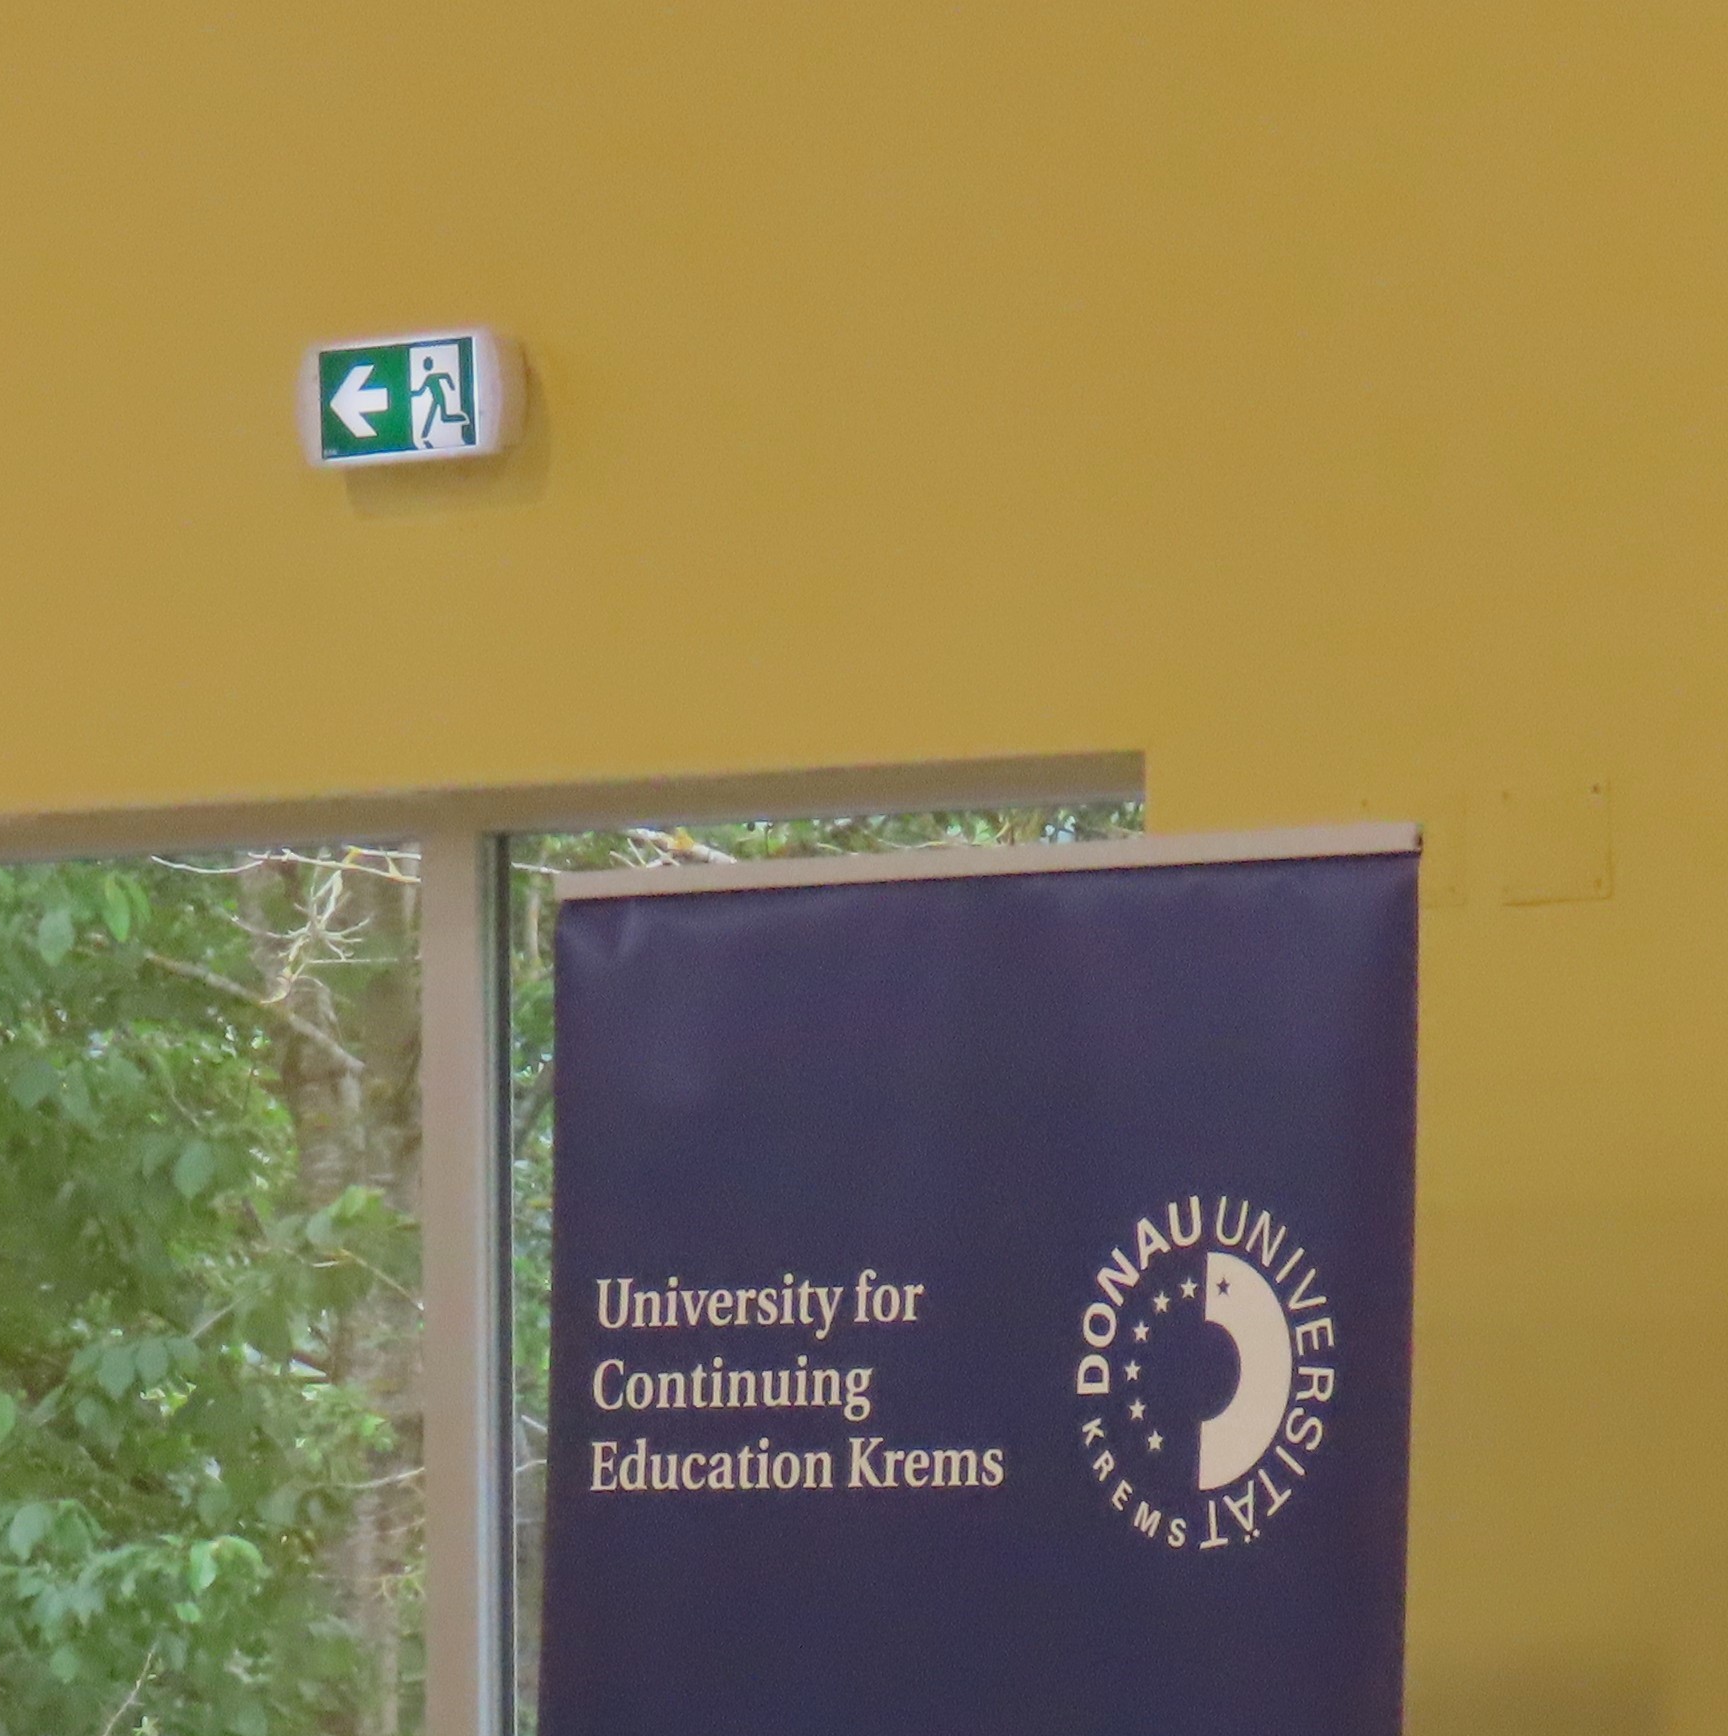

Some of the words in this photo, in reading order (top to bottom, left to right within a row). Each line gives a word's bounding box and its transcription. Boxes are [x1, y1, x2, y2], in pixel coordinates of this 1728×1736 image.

[596, 1274, 846, 1340] University
[854, 1269, 925, 1324] for
[1076, 1196, 1201, 1396] DONAU
[591, 1353, 874, 1421] Continuing
[1199, 1196, 1336, 1549] UNIVERSITÄT
[589, 1437, 834, 1494] Education
[847, 1435, 1006, 1490] Krems
[1081, 1419, 1186, 1548] KREMS
